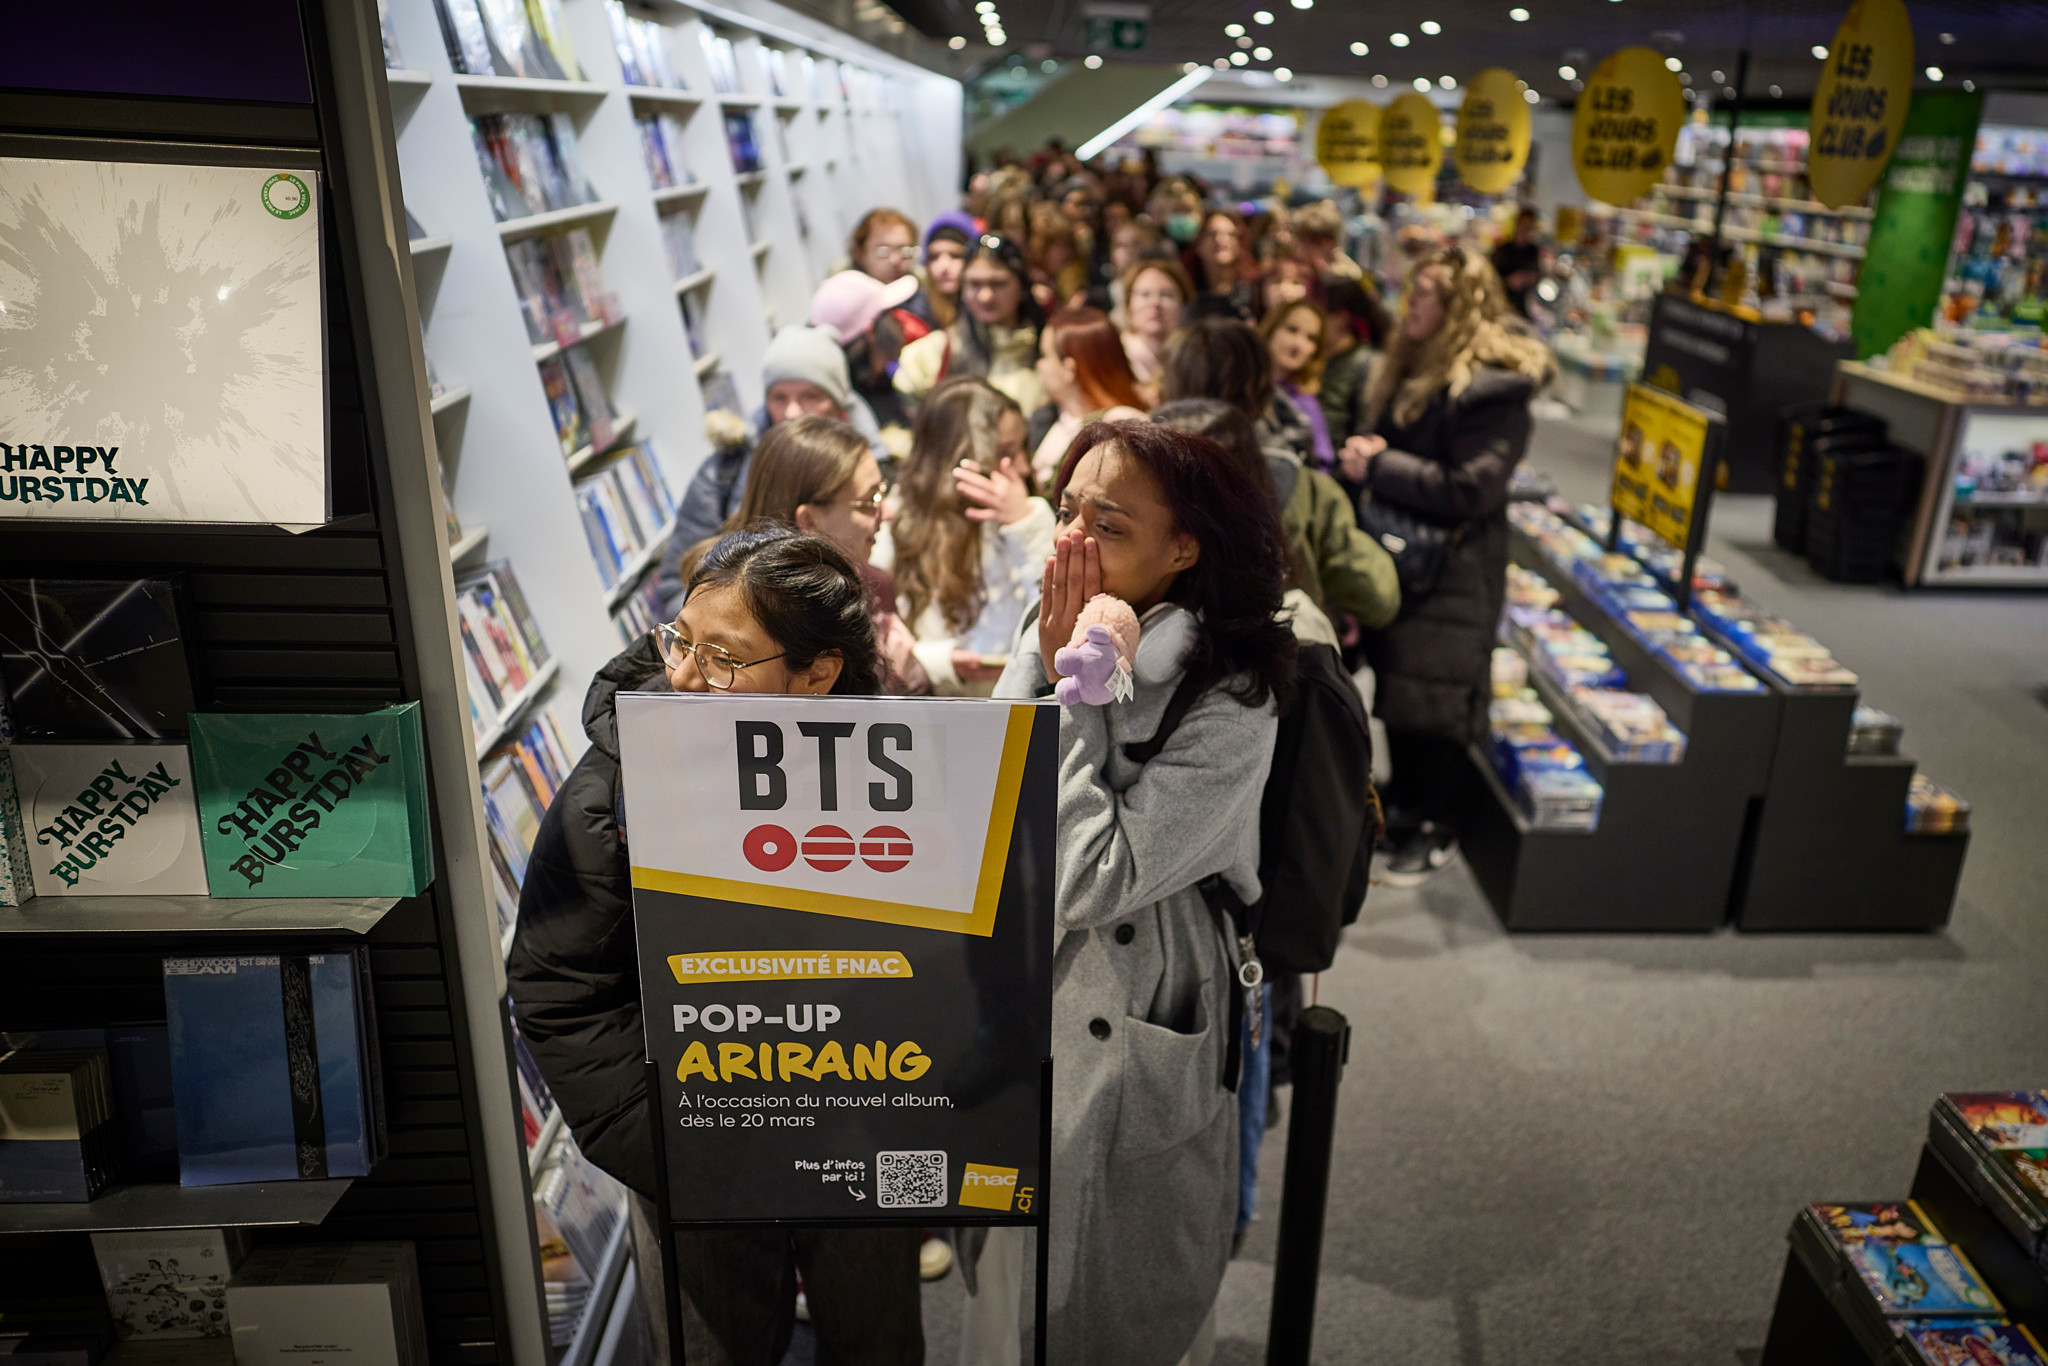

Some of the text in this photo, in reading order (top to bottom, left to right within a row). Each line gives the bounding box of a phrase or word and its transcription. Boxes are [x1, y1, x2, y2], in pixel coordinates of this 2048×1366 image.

[1837, 41, 1873, 80] LES
[1591, 85, 1634, 114] LES
[1827, 82, 1888, 122] JOURS
[1588, 116, 1657, 142] JOURS
[1818, 125, 1865, 159] CLUB
[1582, 145, 1635, 171] CLUB
[0, 442, 119, 475] HAPPY
[0, 476, 149, 506] URSTDAY
[735, 721, 913, 812] BTS
[217, 730, 337, 843] HAPPY
[37, 758, 136, 851] HAPPY
[229, 733, 390, 890] BURSTDAY
[49, 761, 181, 890] BURSTDAY
[681, 954, 900, 975] EXCLUSIVITÉ FNAC
[672, 1004, 841, 1033] POP-UP
[676, 1040, 932, 1083] ARIRANG
[678, 1091, 954, 1109] À l'occasion du nouvel album,
[680, 1113, 815, 1127] dès le 20 mars
[794, 1159, 866, 1170] Plus d'infos
[822, 1173, 842, 1184] par
[844, 1171, 858, 1182] ici
[963, 1171, 1018, 1187] fnac
